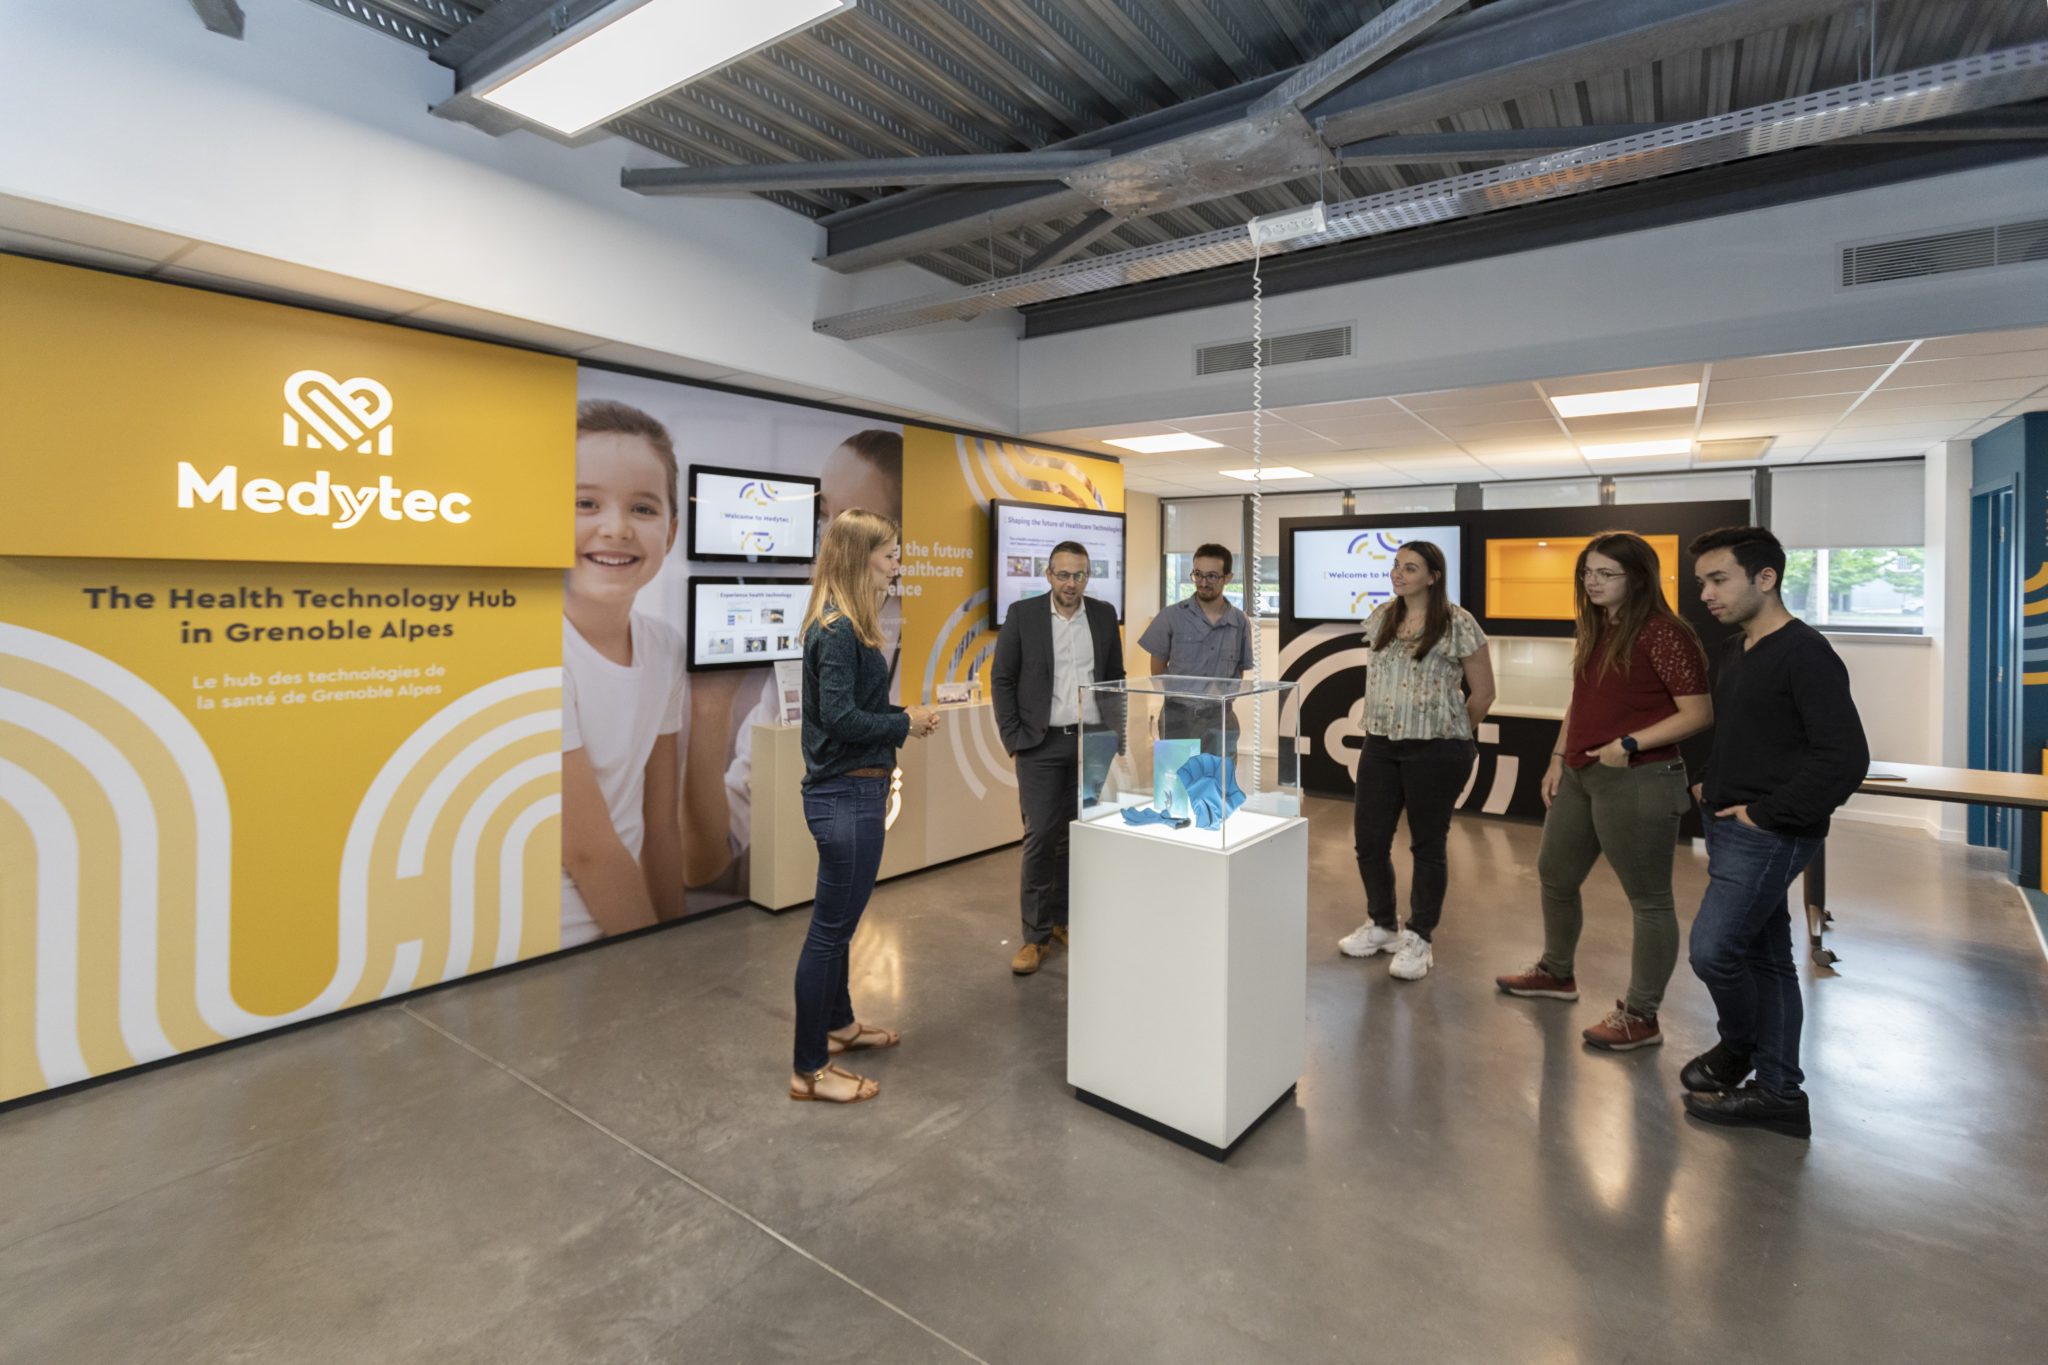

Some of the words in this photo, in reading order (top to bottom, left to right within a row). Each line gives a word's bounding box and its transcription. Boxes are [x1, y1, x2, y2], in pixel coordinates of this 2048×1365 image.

[177, 461, 473, 530] Medytec
[724, 512, 754, 520] Welcome
[1008, 516, 1030, 527] Shaping
[1031, 518, 1041, 526] the
[1042, 519, 1058, 527] future
[905, 540, 929, 557] the
[933, 541, 974, 559] future
[1328, 571, 1368, 579] Welcome
[82, 585, 156, 609] The
[168, 586, 284, 609] Health
[292, 587, 460, 612] Technology
[467, 588, 517, 608] Hub
[180, 620, 213, 644] in
[225, 618, 372, 643] Grenoble
[380, 618, 454, 643] Alpes
[192, 674, 218, 690] Le
[223, 672, 263, 688] hub
[267, 671, 303, 686] des
[308, 664, 421, 684] technologies
[424, 663, 447, 678] de
[196, 694, 216, 711] la
[221, 690, 276, 709] santé
[281, 690, 306, 706] de
[311, 683, 394, 703] Grenoble
[397, 681, 442, 699] Alpes
